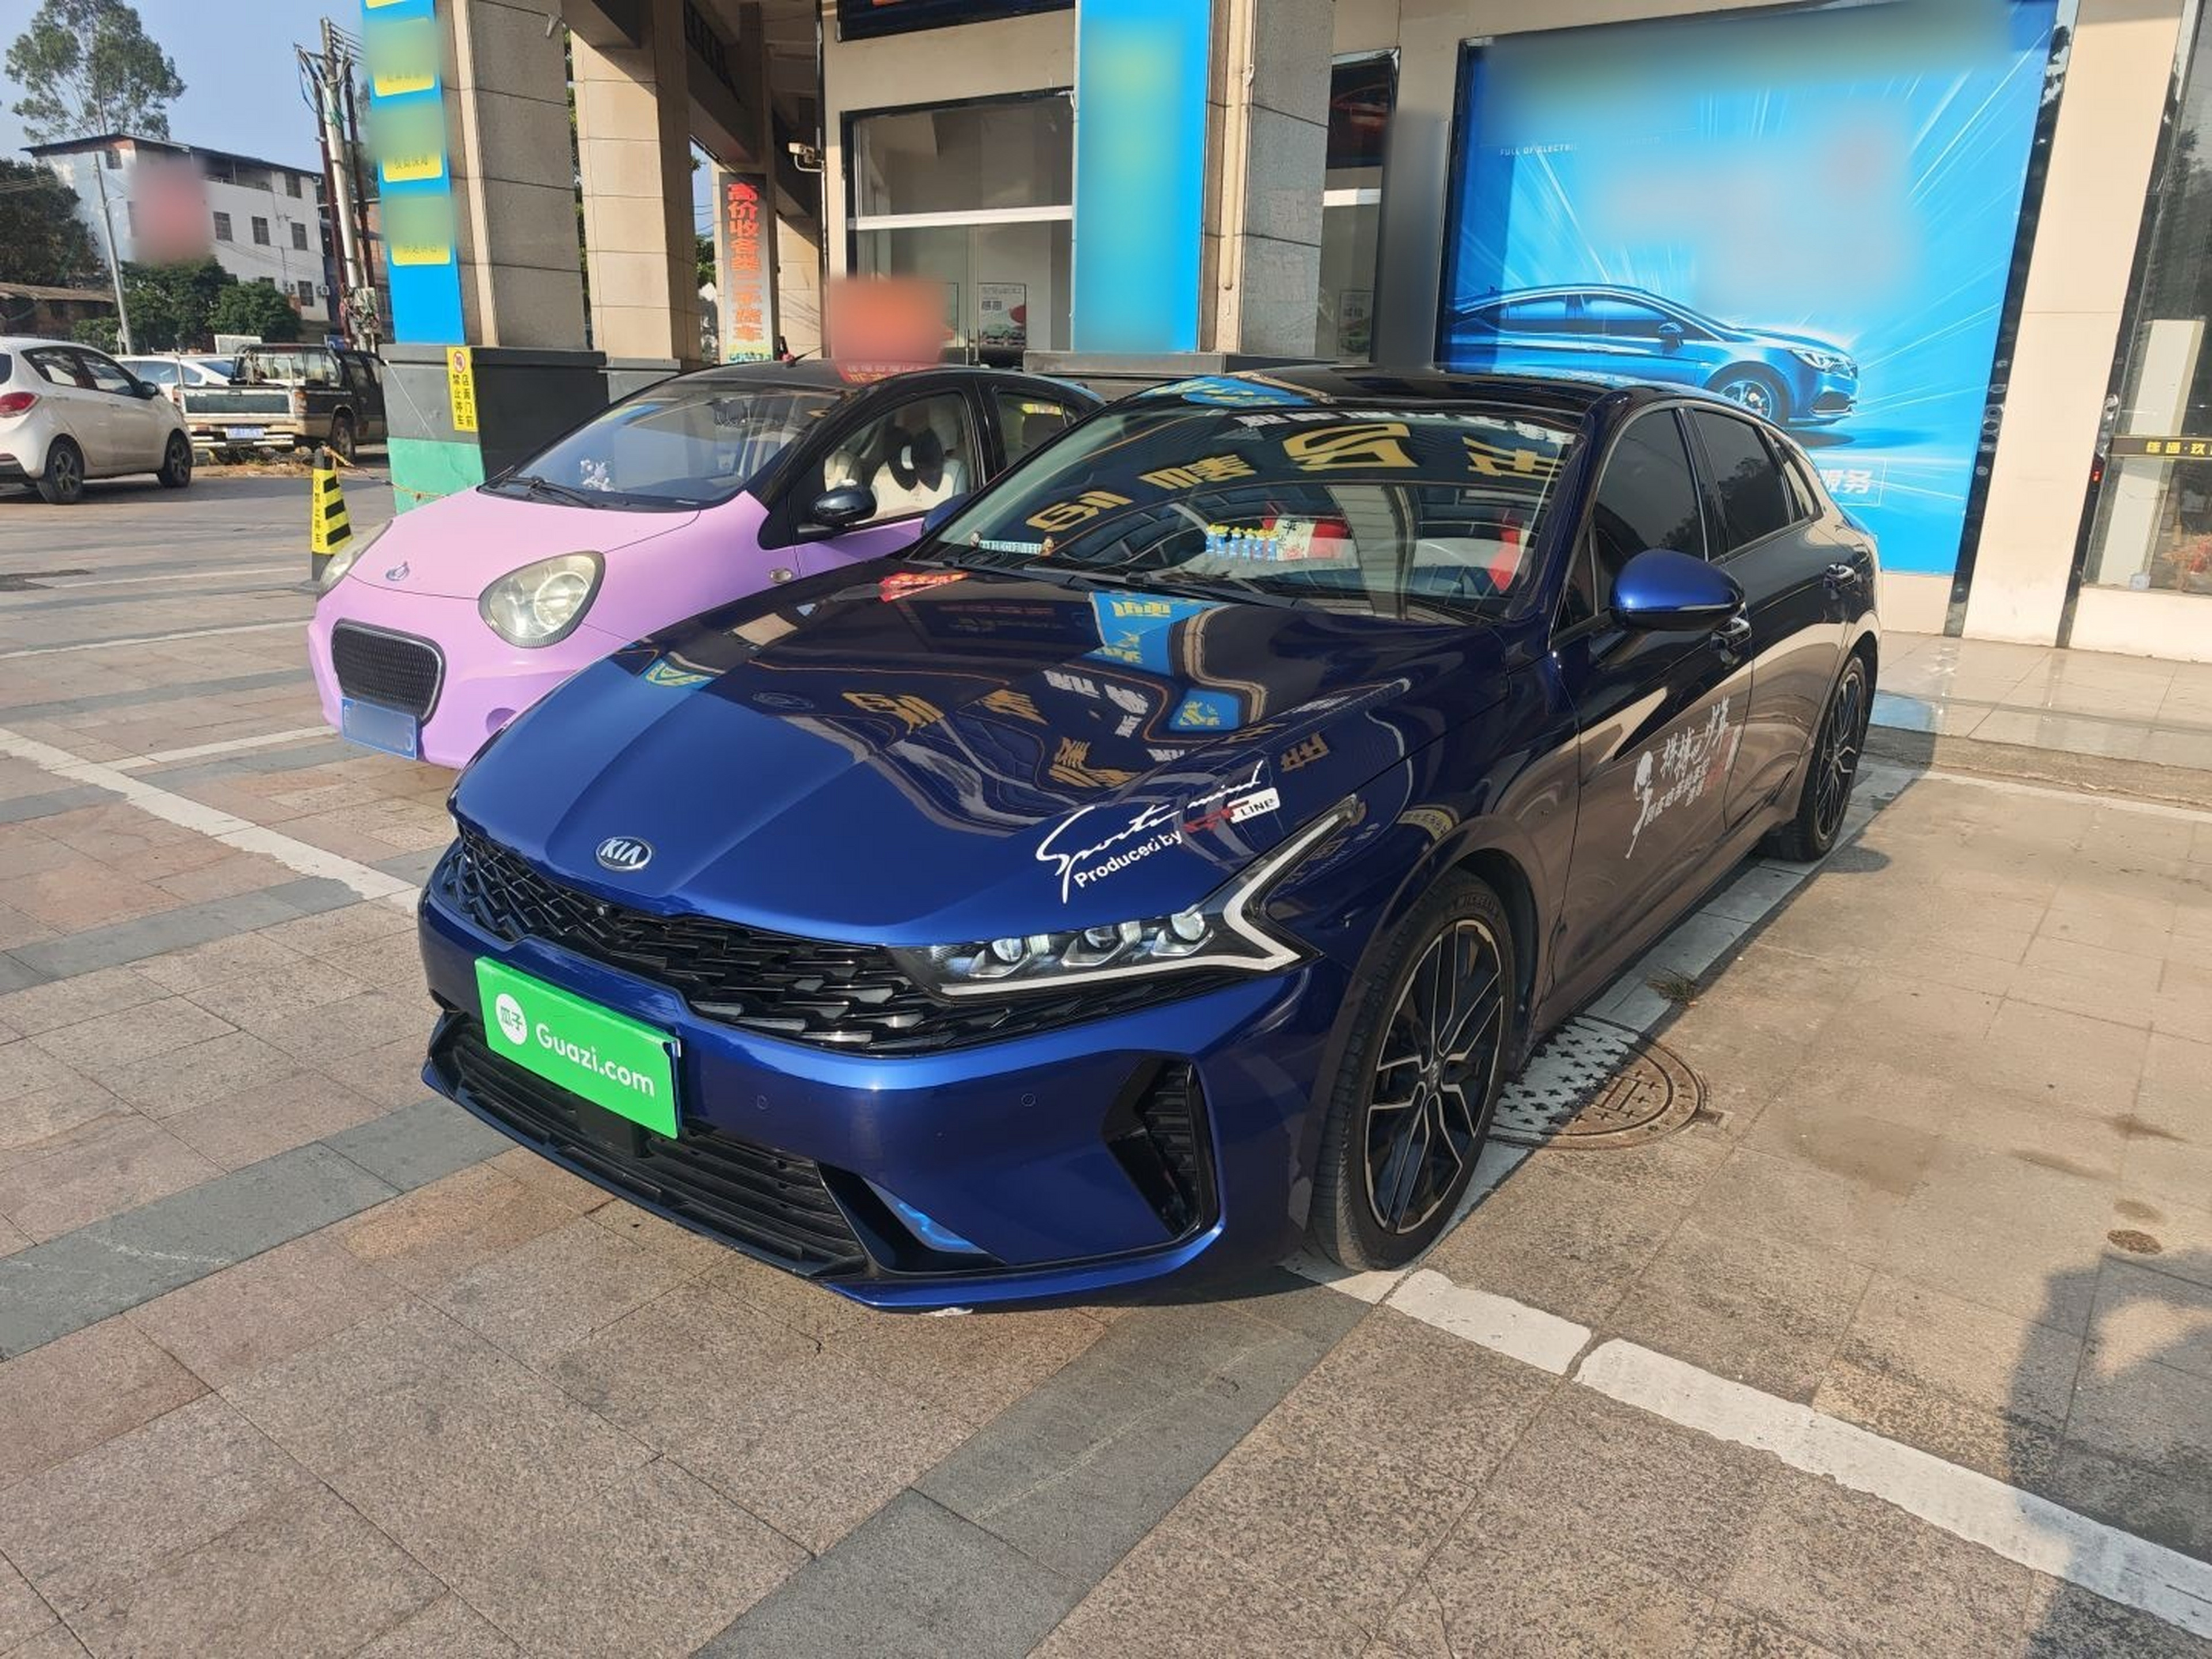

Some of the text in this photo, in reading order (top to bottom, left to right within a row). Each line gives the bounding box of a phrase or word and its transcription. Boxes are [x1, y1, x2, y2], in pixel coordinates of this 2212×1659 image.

[600, 839, 642, 864] KIA
[1073, 830, 1183, 888] Produced by
[536, 1023, 656, 1097] Guazi.com
